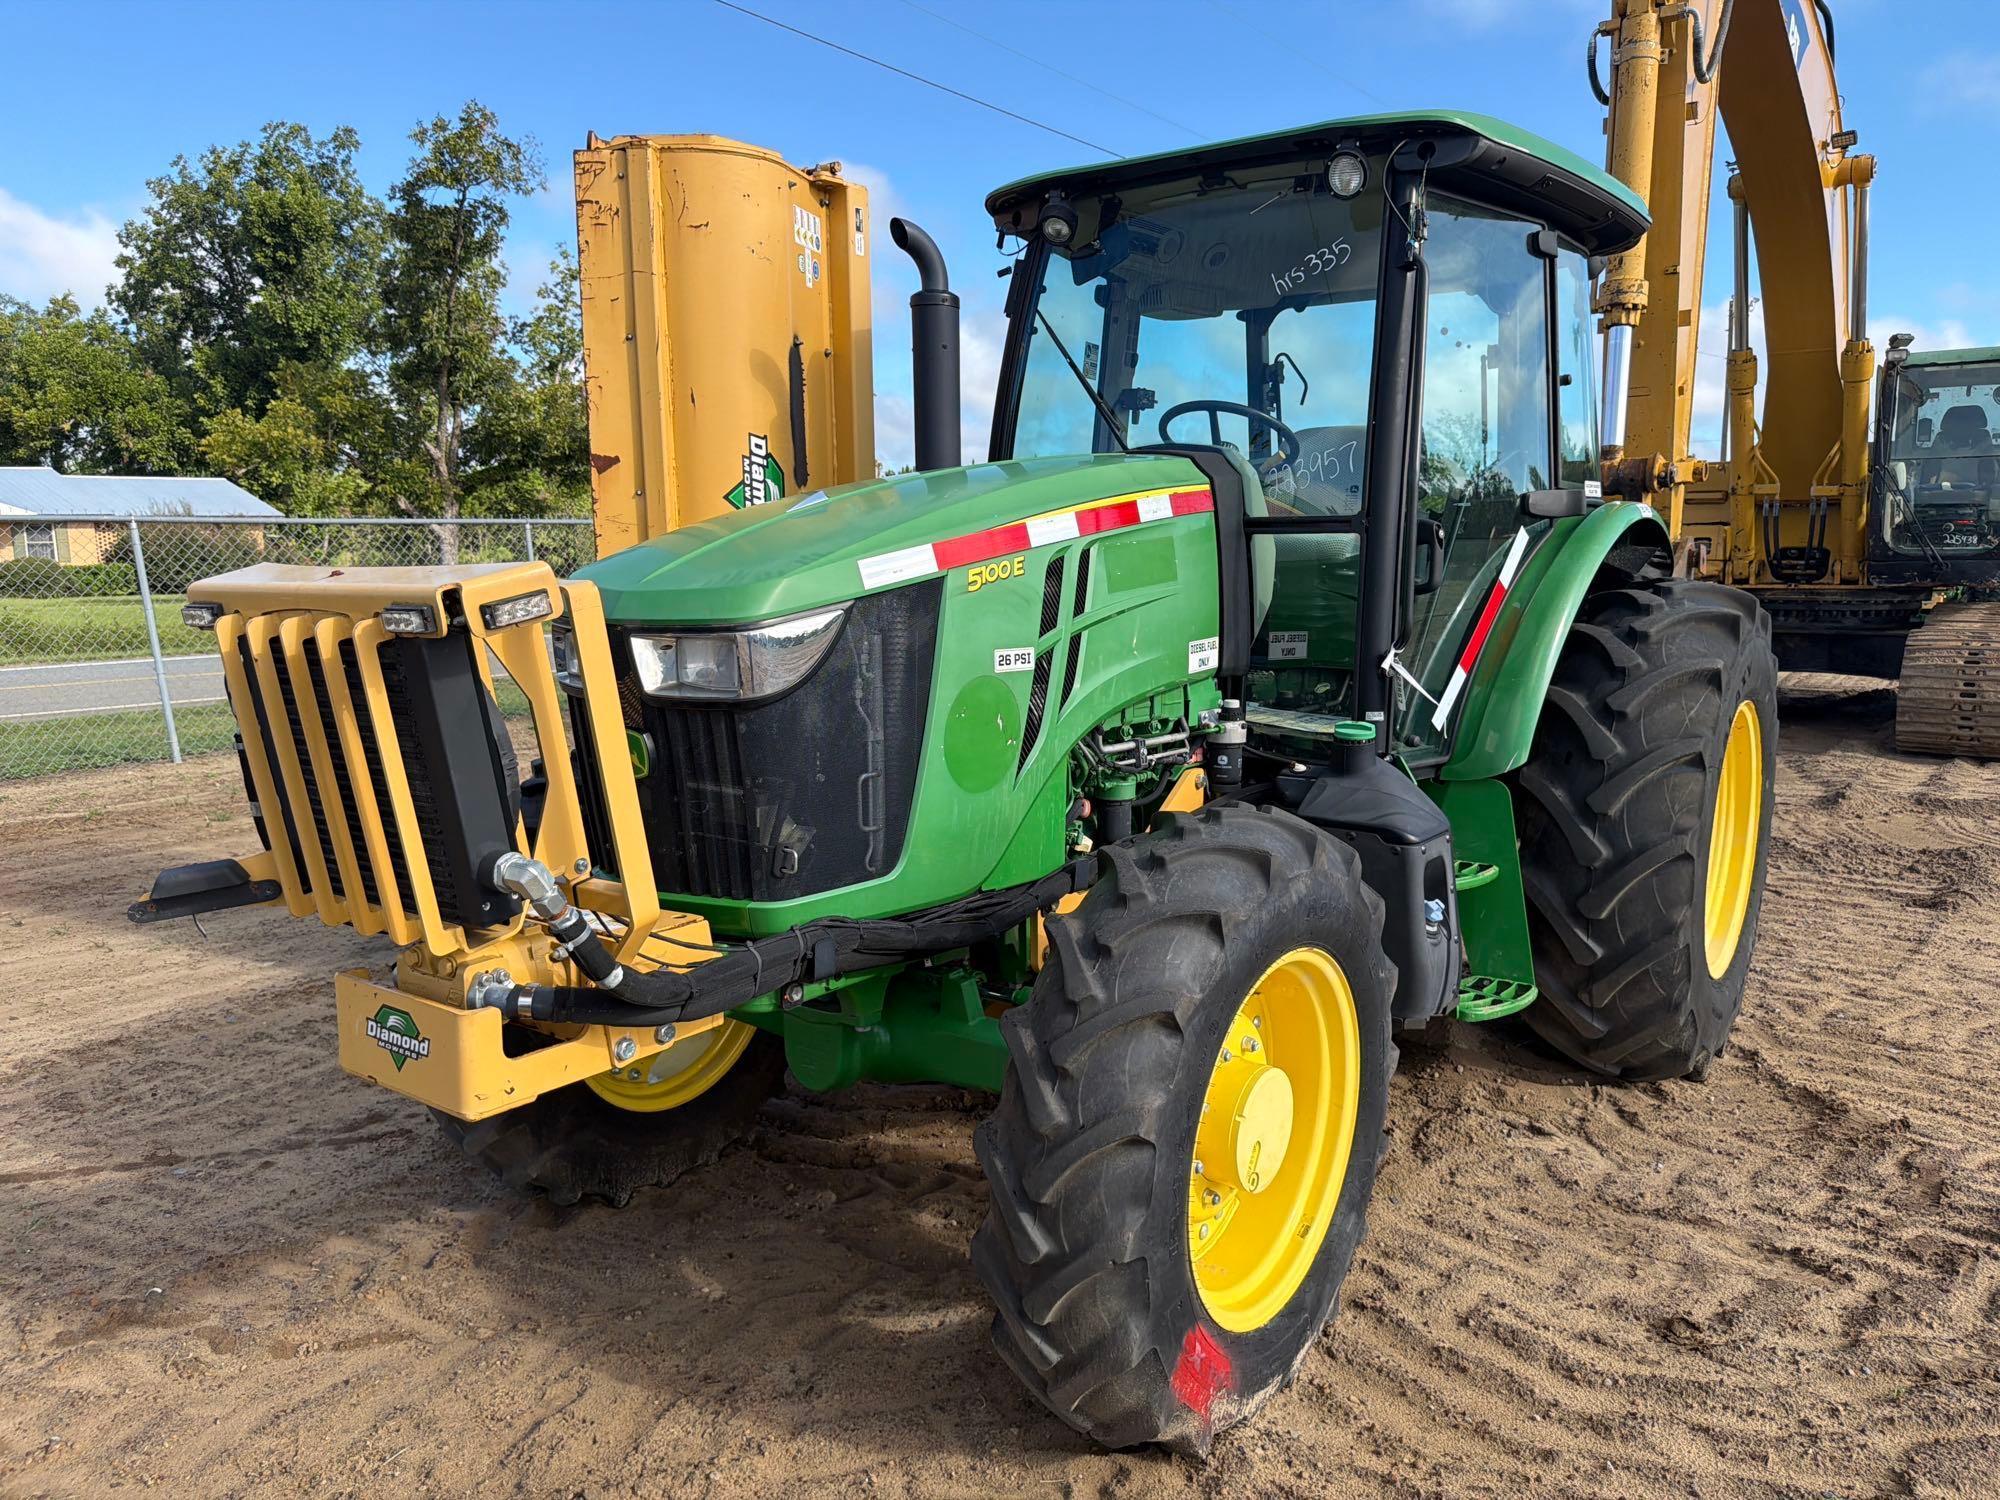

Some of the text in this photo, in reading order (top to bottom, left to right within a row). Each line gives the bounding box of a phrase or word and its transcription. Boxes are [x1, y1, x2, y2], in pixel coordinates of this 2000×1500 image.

[1190, 640, 1218, 654] DIESEL FUEL
[998, 652, 1032, 666] 26 PSI
[1198, 656, 1210, 668] ONLY
[367, 1019, 430, 1056] Diamond
[378, 1041, 418, 1059] MOWERS
